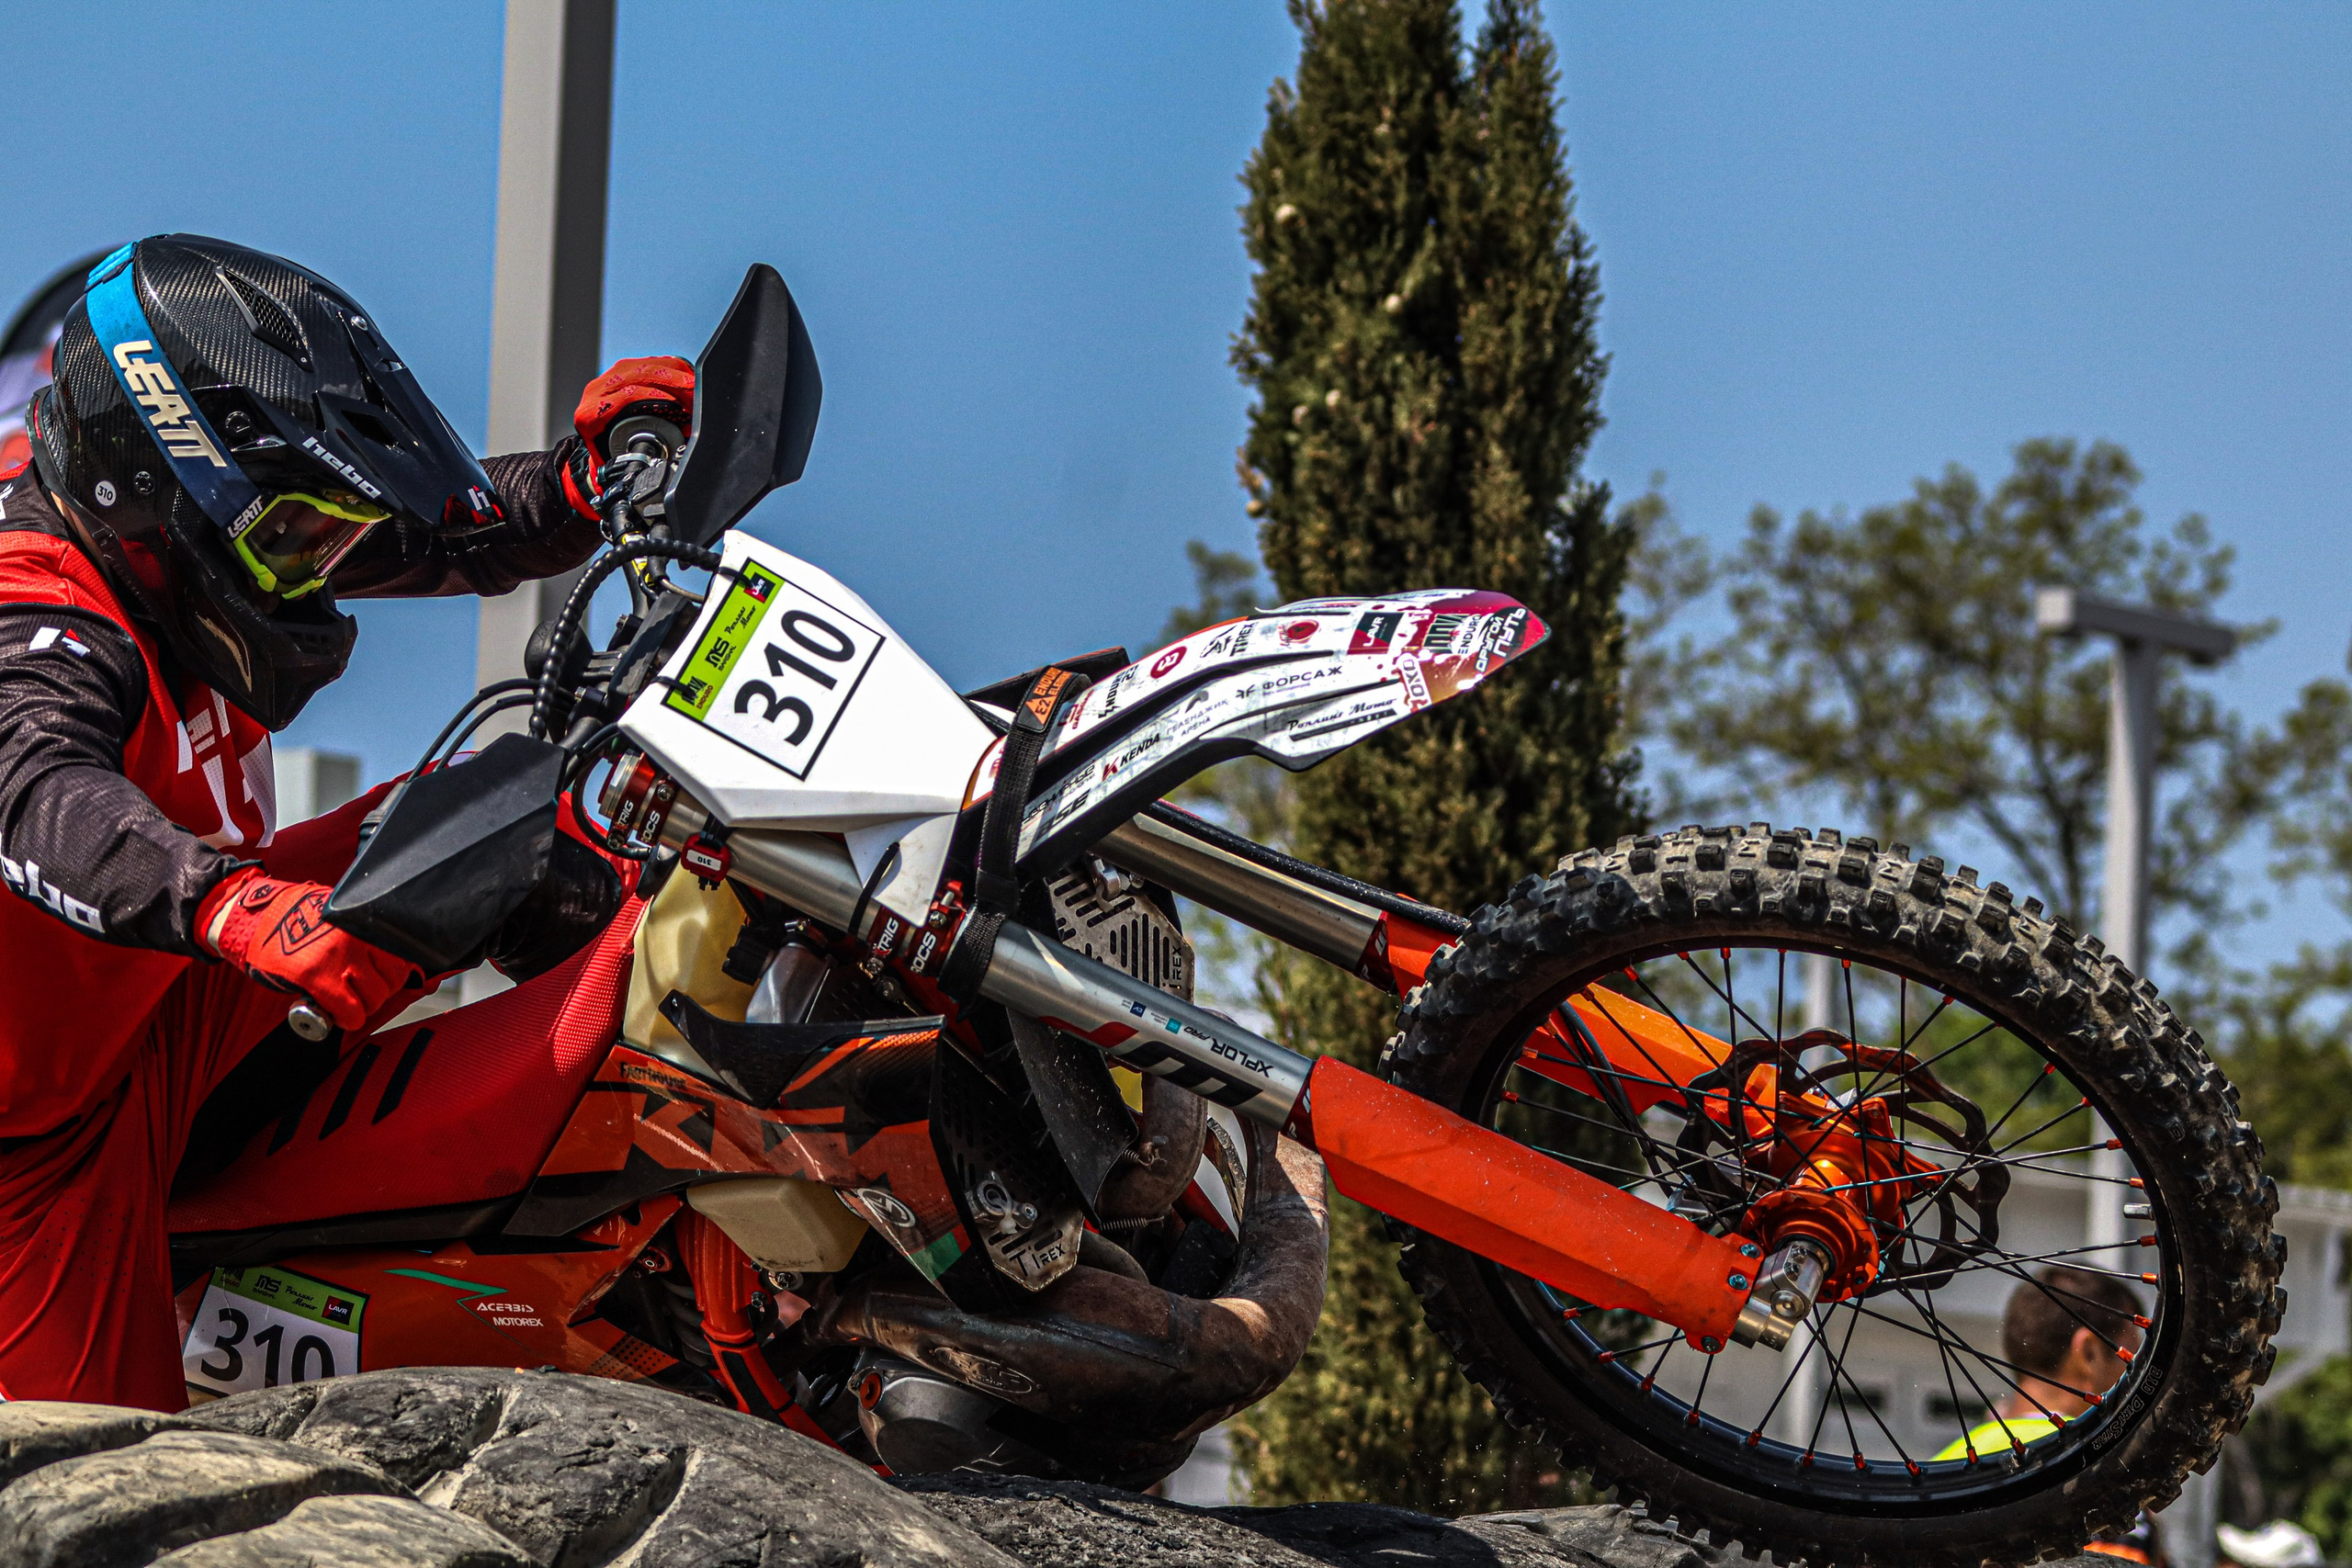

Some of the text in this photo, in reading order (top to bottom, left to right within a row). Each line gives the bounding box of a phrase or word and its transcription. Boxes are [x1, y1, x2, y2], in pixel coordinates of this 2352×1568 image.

[113, 340, 228, 468] LEATT
[302, 436, 382, 499] hebo
[97, 485, 113, 502] 310
[227, 494, 264, 539] LEATT
[1363, 616, 1385, 648] LAVR
[1457, 614, 1482, 655] ENDURO
[1475, 616, 1505, 671] ДРУГОЙ
[1494, 607, 1526, 658] ПУТЬ
[734, 608, 857, 748] 310
[1262, 665, 1343, 690] ФОРСАЖ
[696, 685, 714, 710] ENDURO
[1181, 717, 1211, 737] АРЕНА
[1120, 733, 1160, 767] KENDA
[697, 855, 712, 866] 310
[1183, 1026, 1274, 1077] XPLOR PRO
[328, 1303, 348, 1315] LAVR
[492, 1316, 545, 1327] MOTOREX
[200, 1307, 336, 1389] 310
